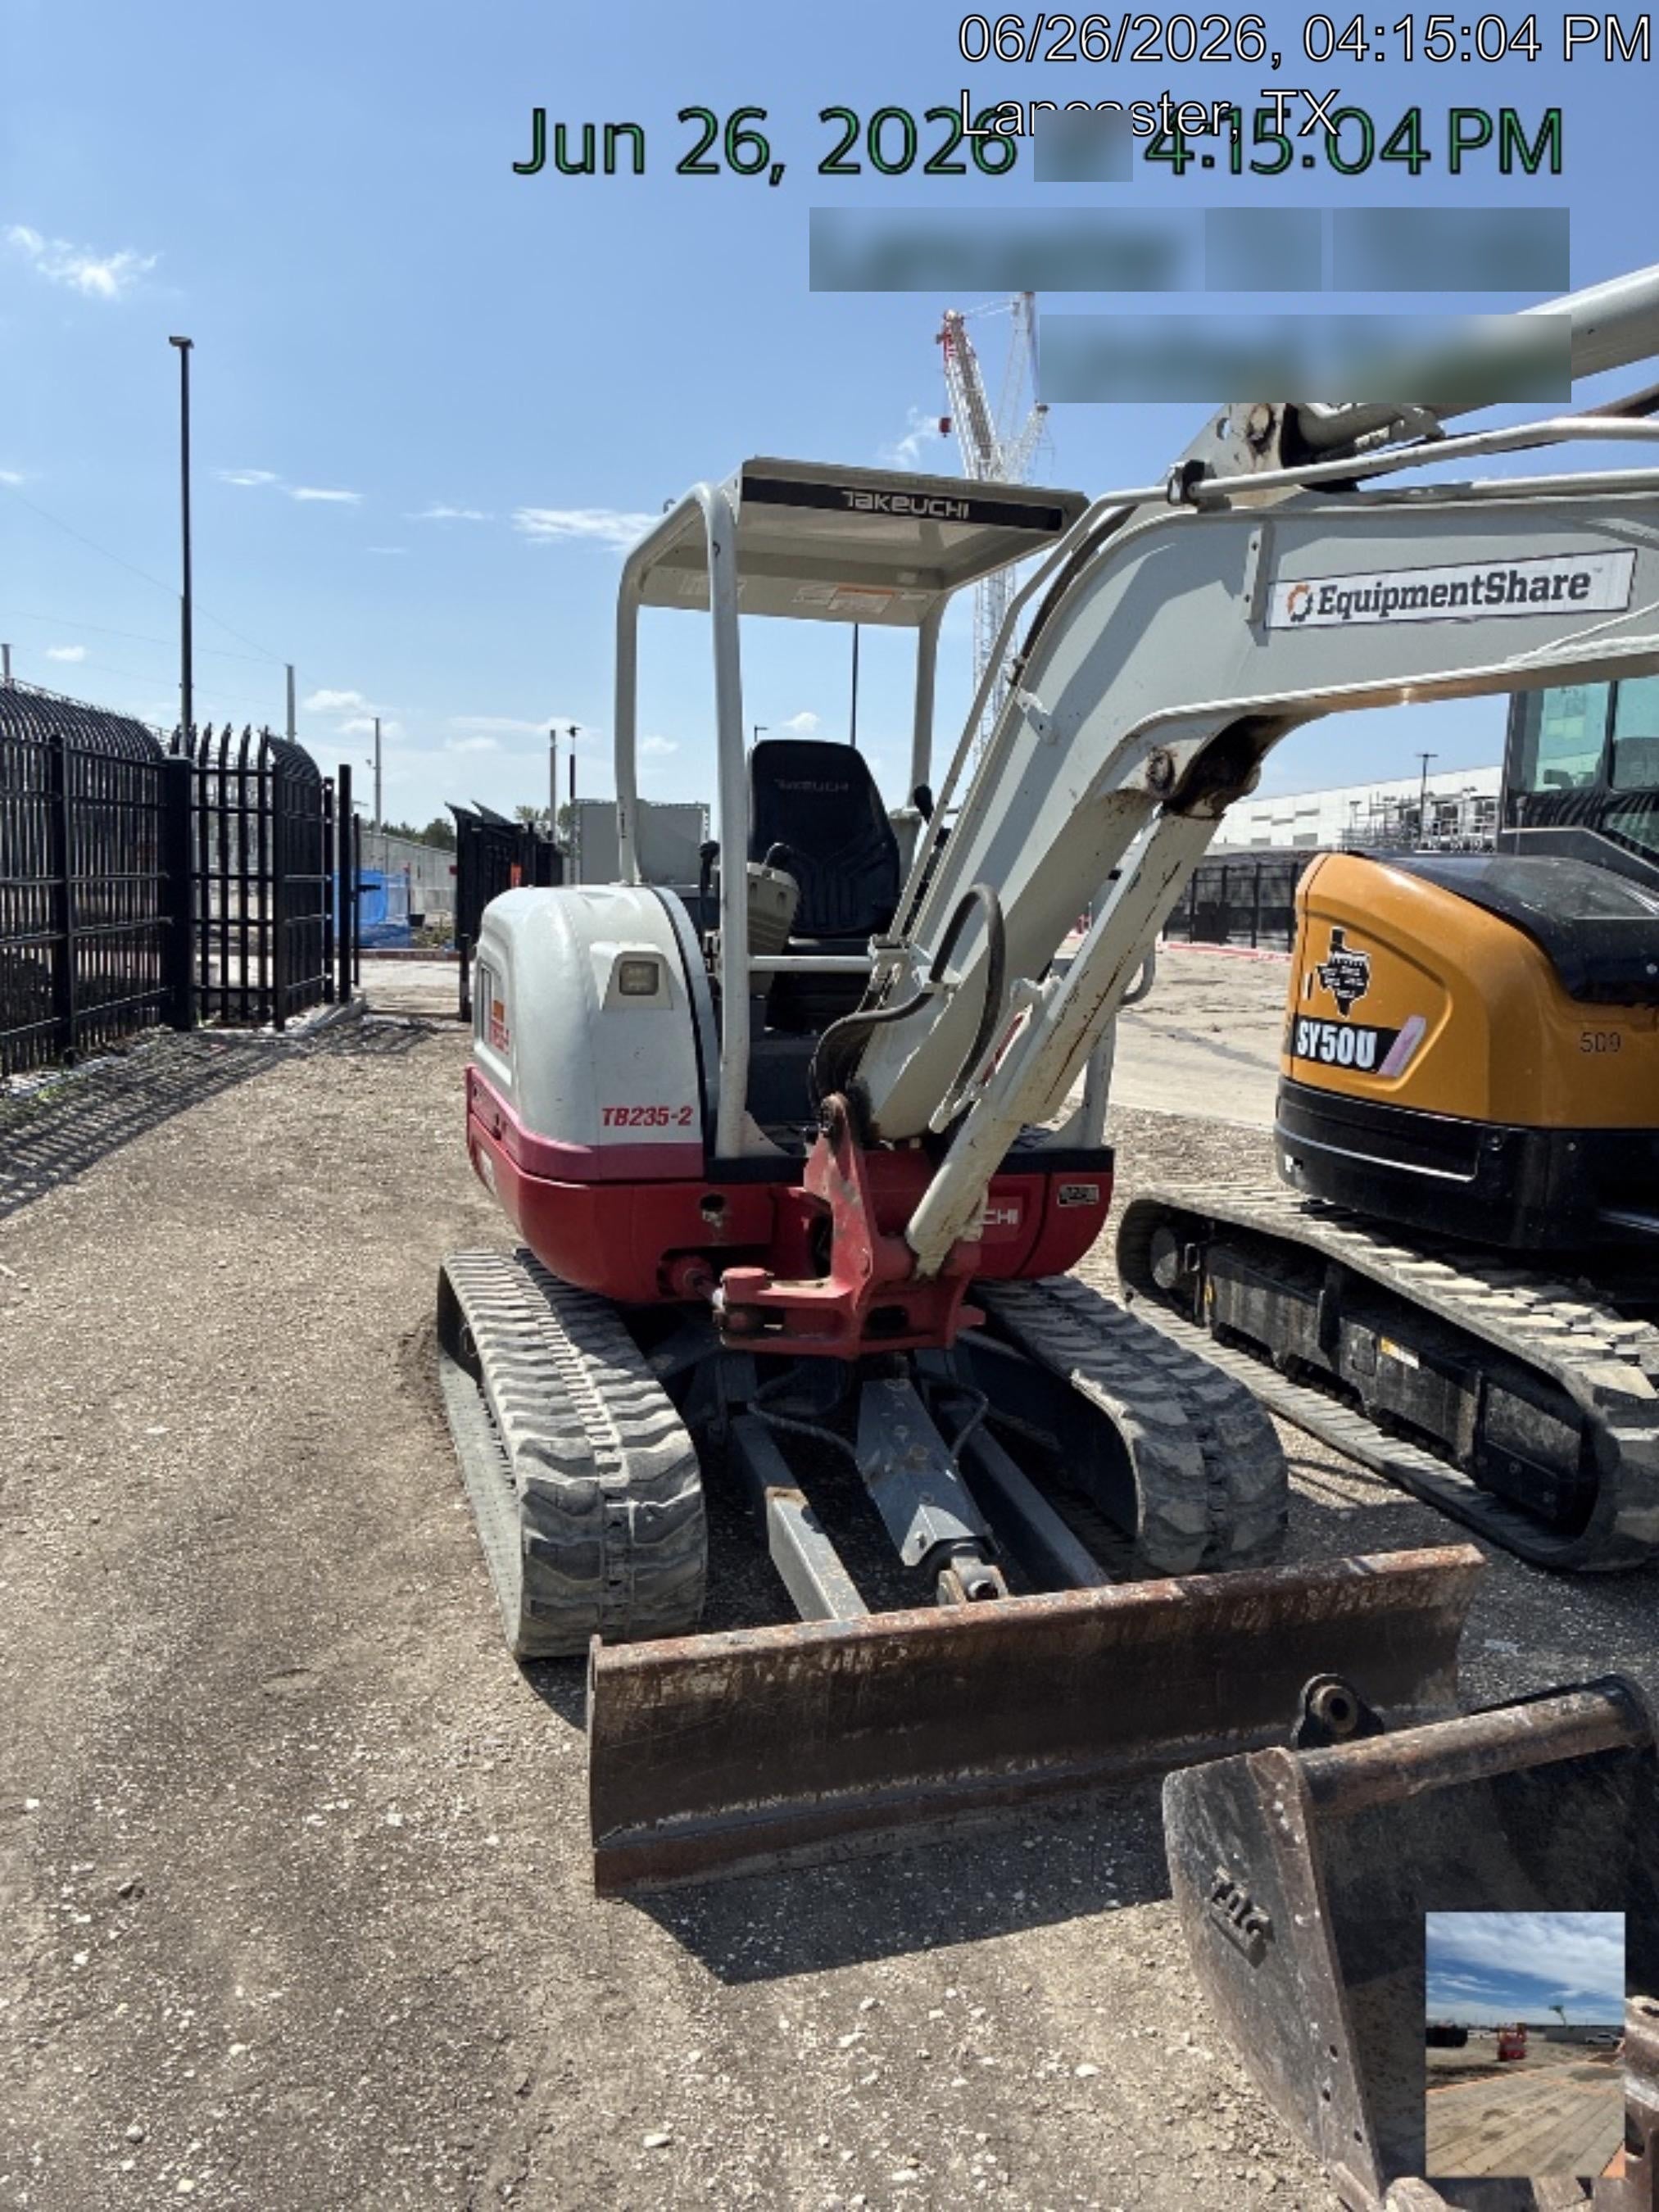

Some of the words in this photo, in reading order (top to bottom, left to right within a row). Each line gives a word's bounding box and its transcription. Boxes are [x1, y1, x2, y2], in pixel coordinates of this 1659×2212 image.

[1317, 570, 1591, 619] EquipmentShare
[1297, 1020, 1376, 1067] SY50U
[602, 1107, 693, 1126] TB235-2
